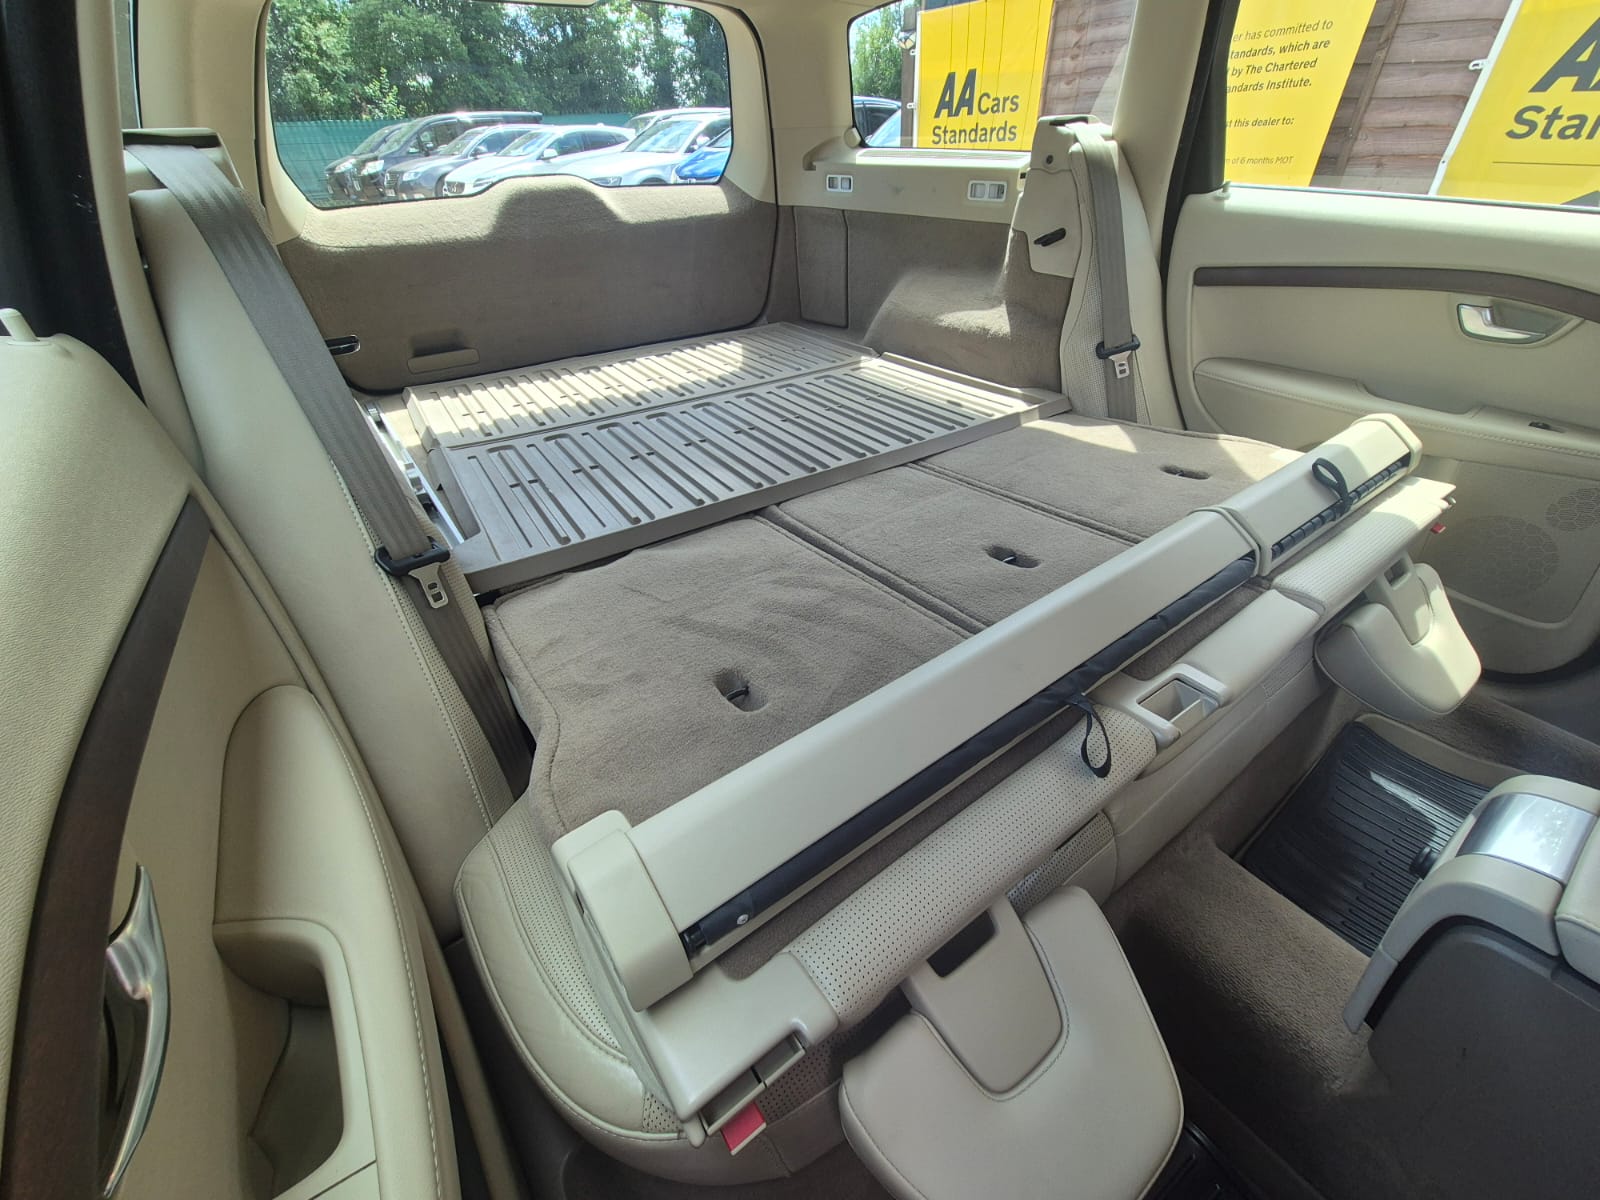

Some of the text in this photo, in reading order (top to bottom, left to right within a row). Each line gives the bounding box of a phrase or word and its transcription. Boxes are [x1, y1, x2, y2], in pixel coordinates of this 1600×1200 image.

[1244, 30, 1262, 41] has
[1263, 20, 1320, 39] committed
[1321, 19, 1334, 31] to
[1279, 41, 1310, 54] which
[1311, 39, 1331, 50] are
[1231, 57, 1318, 78] by The Chartered
[1266, 77, 1312, 90] Institute.
[934, 68, 1020, 119] AA Cars
[1234, 117, 1250, 127] this
[1251, 116, 1281, 127] dealer
[1281, 116, 1295, 126] to:
[931, 120, 1018, 145] Standards
[1246, 156, 1275, 165] months
[1275, 155, 1295, 165] MOT
